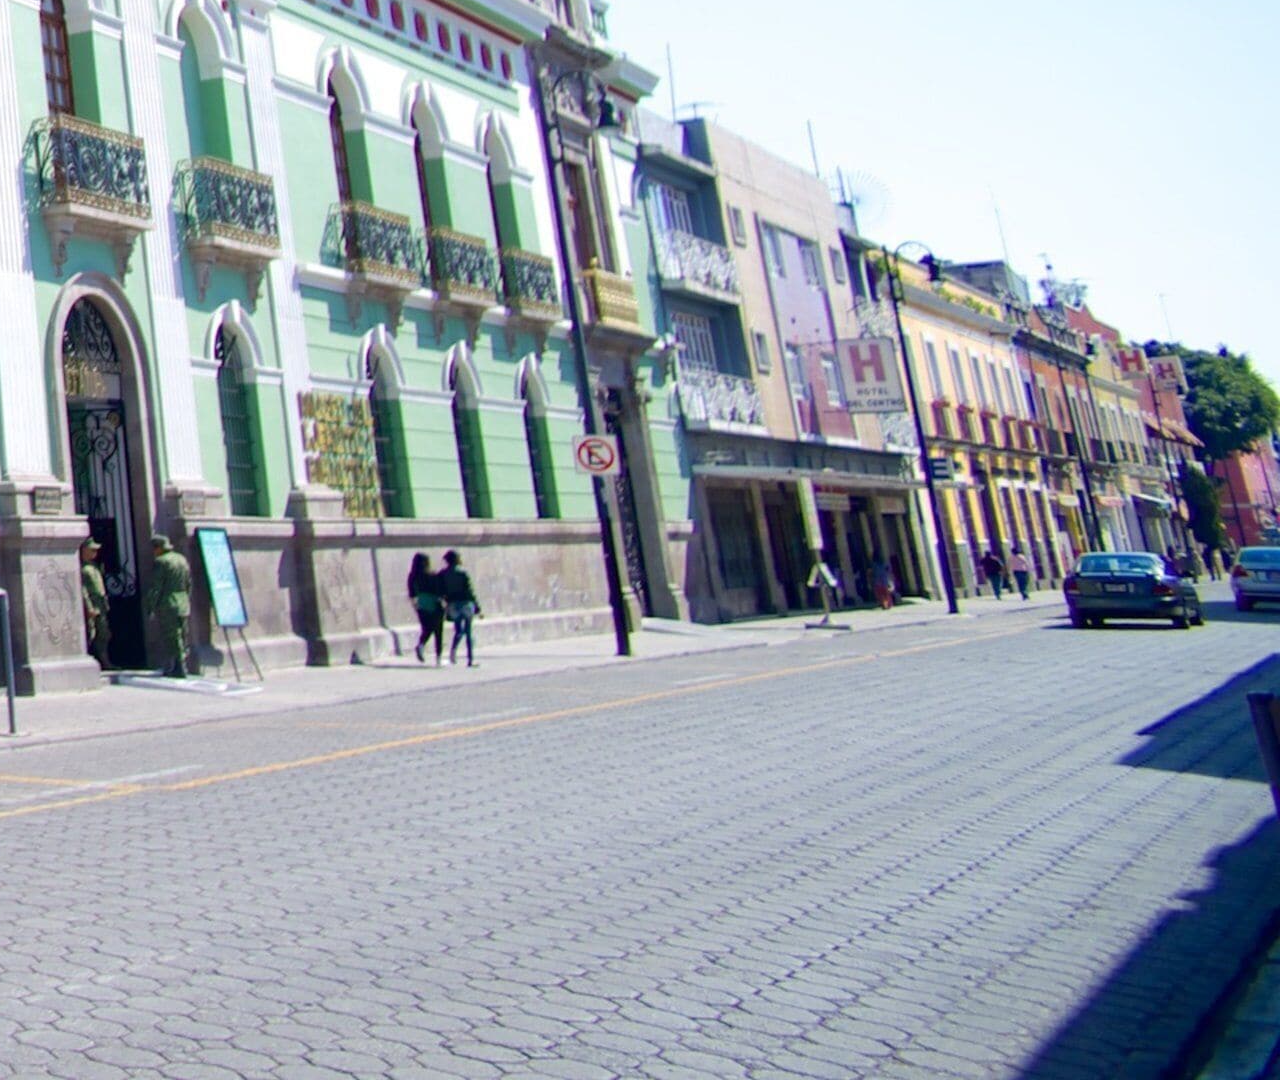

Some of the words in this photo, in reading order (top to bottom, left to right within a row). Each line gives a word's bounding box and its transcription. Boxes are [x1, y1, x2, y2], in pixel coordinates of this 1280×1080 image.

[849, 344, 886, 382] H
[1119, 350, 1145, 372] H
[857, 387, 888, 395] HOTEL
